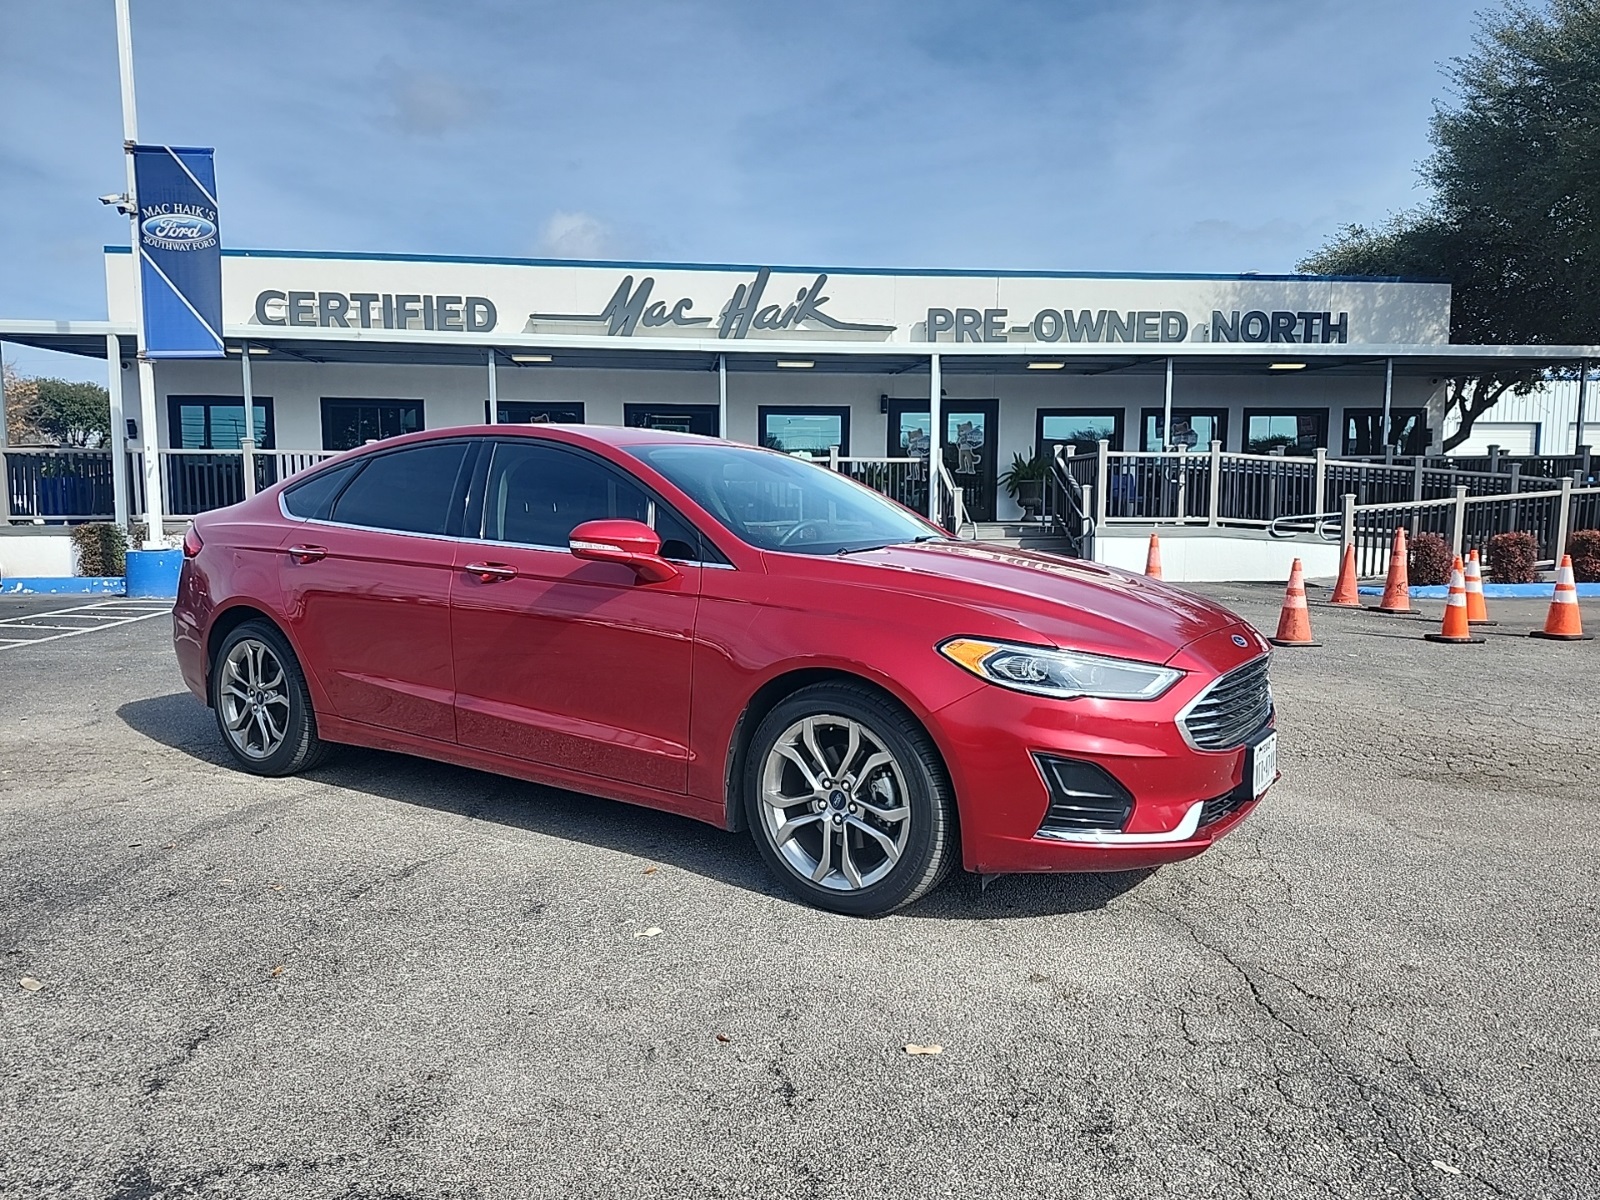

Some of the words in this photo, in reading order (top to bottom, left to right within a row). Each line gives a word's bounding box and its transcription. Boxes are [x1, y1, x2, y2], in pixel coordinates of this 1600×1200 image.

[141, 203, 171, 219] MAC
[174, 203, 216, 221] HAIK'S
[155, 218, 202, 238] Ford
[142, 236, 192, 252] SOUTHWAY
[193, 238, 217, 251] FORD
[254, 289, 498, 333] CERTIFIED
[529, 275, 713, 337] Mac
[717, 266, 897, 340] Haik
[926, 307, 1189, 344] PRE-OWNED
[1211, 310, 1349, 344] NORTH
